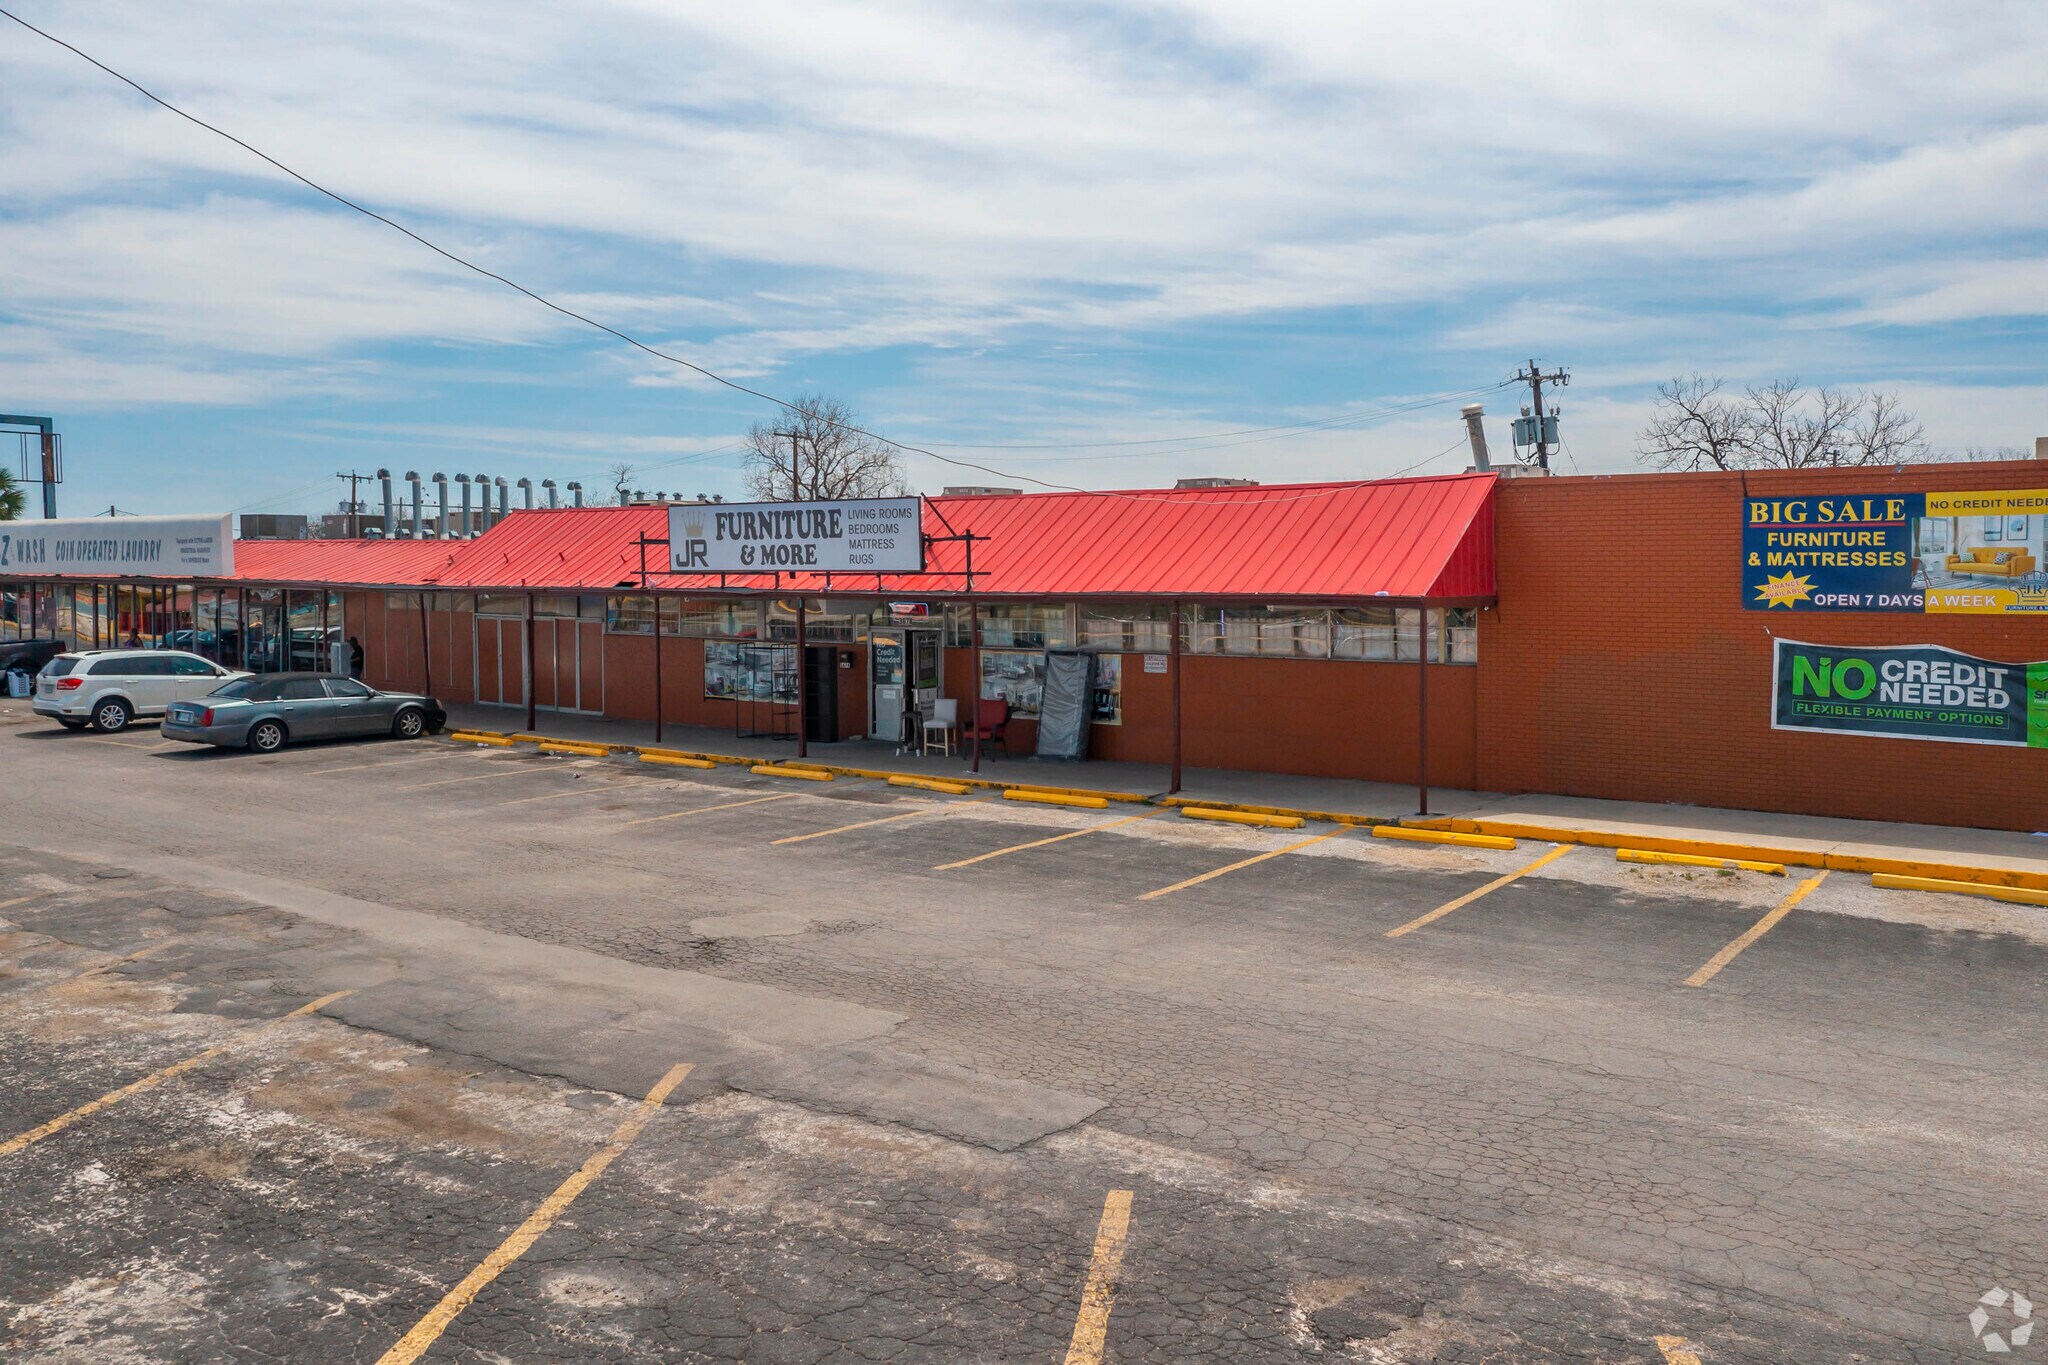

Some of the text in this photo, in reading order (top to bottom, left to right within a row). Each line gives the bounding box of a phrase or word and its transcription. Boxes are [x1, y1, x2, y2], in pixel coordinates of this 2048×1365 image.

[1750, 499, 1906, 523] BIG SALE
[1930, 500, 1949, 509] NO
[1953, 499, 2002, 509] CREDIT
[848, 508, 912, 520] LIVING ROOMS
[715, 509, 843, 541] FURNITURE
[848, 524, 900, 535] BEDROOMS
[848, 539, 895, 550] MATTRESS
[1767, 531, 1886, 547] FURNITURE
[16, 537, 46, 564] WASH
[56, 539, 162, 562] COIN OPERATED LAUNDRY
[675, 539, 710, 568] JR
[740, 543, 818, 566] & MORE
[849, 554, 874, 565] RUGS
[1748, 551, 1907, 567] & MATTRESSES
[1764, 586, 1808, 598] AVAILABLE
[1767, 580, 1801, 591] FINANCE
[1814, 594, 1997, 607] OPEN 7 DAYS A WEEK
[1792, 655, 1877, 700] NO
[1880, 660, 2009, 689] CREDIT
[1880, 682, 2011, 709] NEEDED
[1797, 703, 2004, 725] FLEXIBLE PAYMENT OPTIONS
